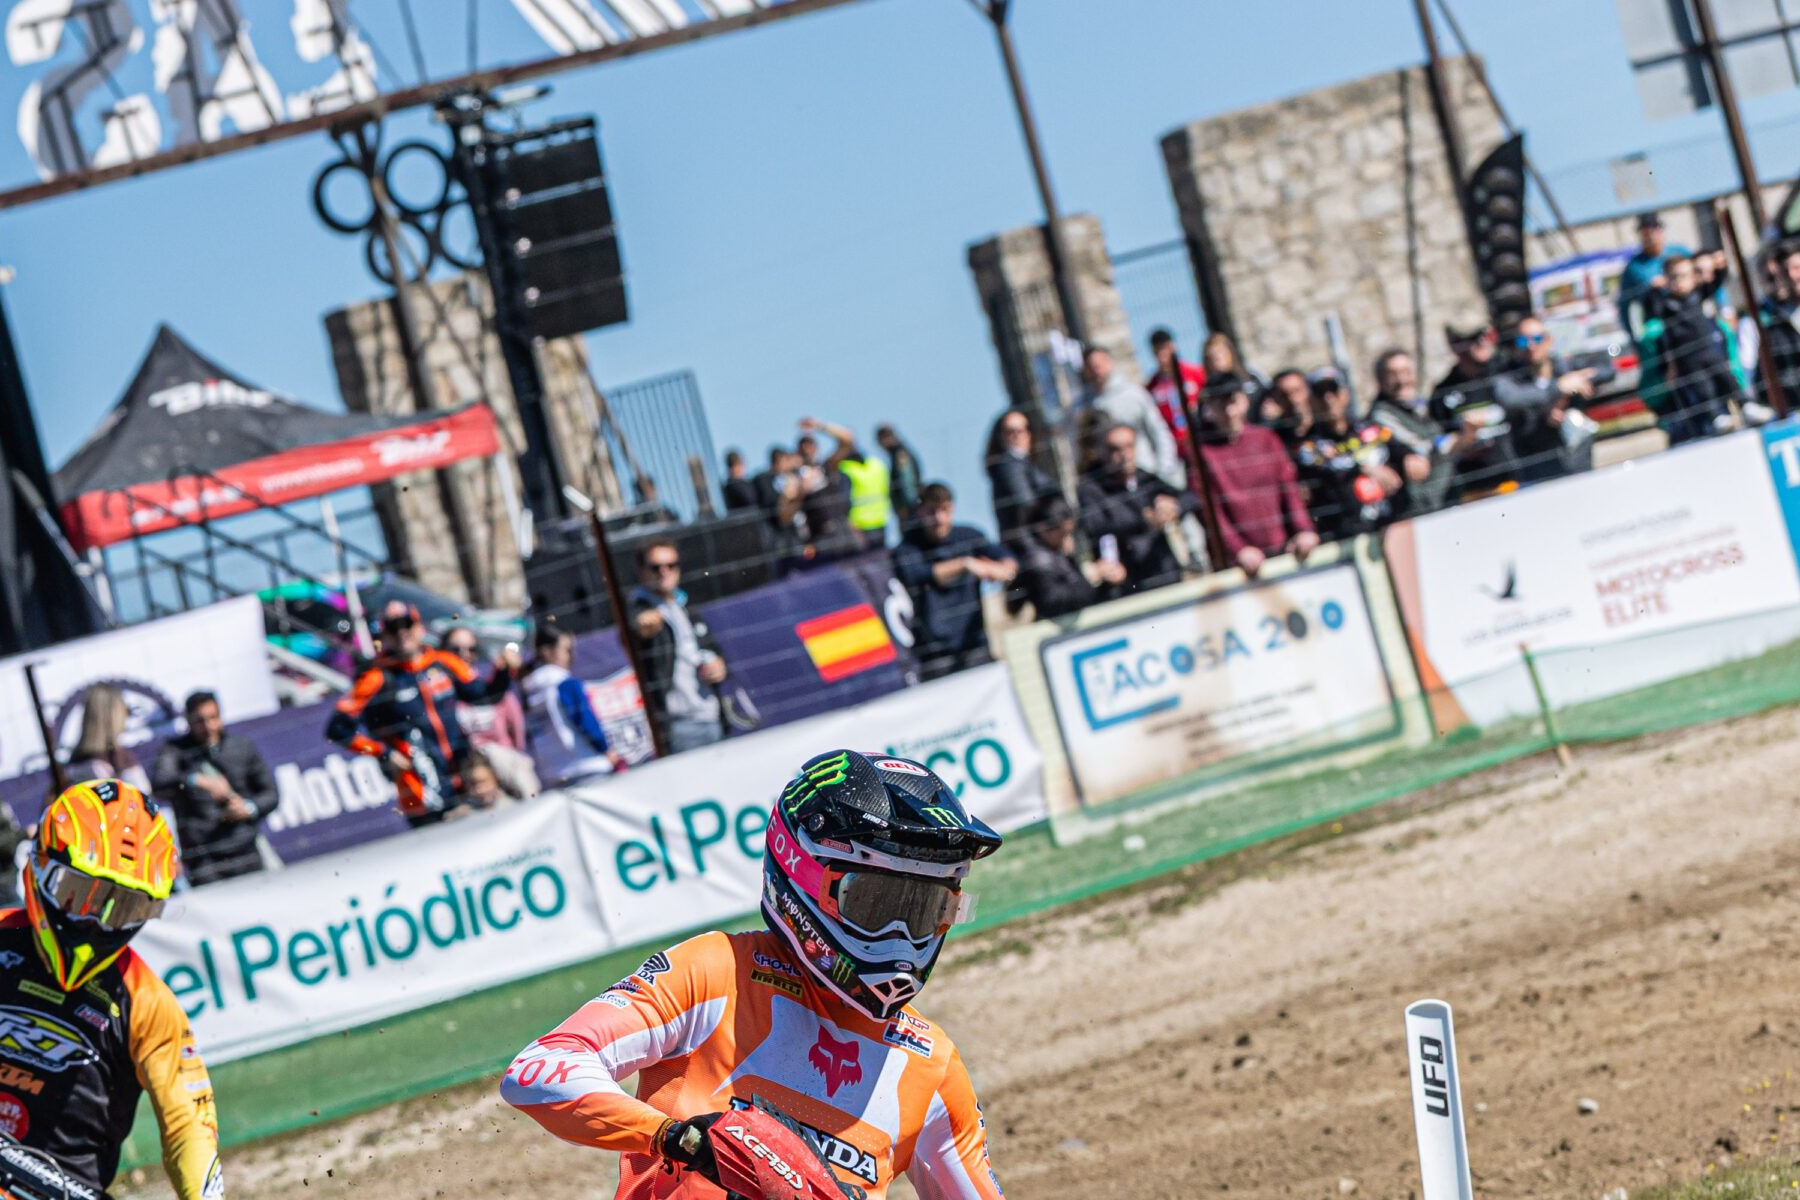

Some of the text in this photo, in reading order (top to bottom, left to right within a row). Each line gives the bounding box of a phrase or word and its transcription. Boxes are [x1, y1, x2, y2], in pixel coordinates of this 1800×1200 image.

[1594, 542, 1746, 599] MOTOCROSS
[1602, 593, 1670, 629] ELITE
[883, 761, 920, 774] BELL
[615, 815, 677, 893] el
[766, 815, 802, 873] FOX
[163, 863, 567, 1020] el Periódico
[506, 1057, 581, 1088] FOX
[1418, 1034, 1450, 1118] UFO
[724, 1124, 804, 1190] ACERBIS
